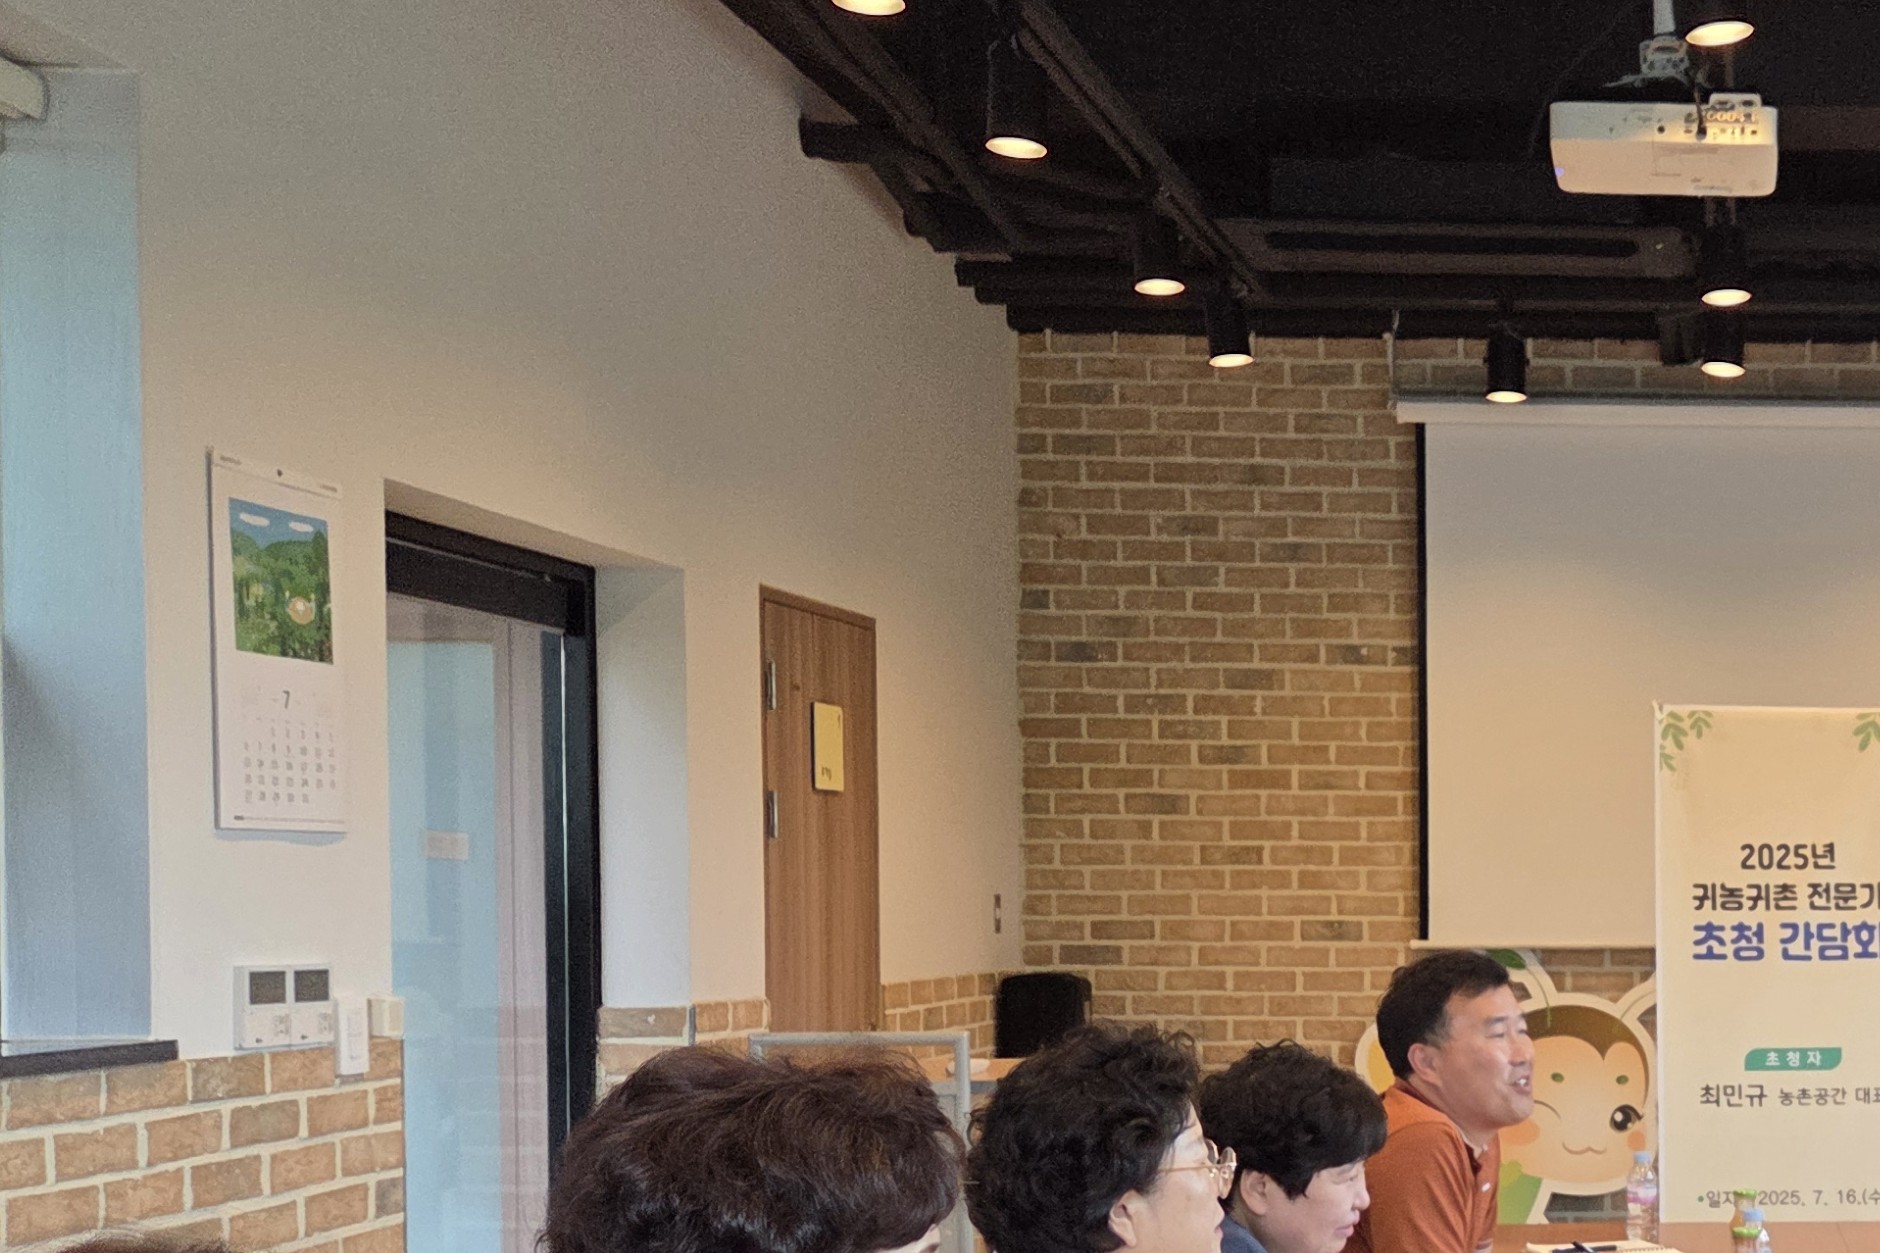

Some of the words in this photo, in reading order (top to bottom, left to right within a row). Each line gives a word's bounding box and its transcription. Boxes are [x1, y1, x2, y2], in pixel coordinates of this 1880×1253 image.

[282, 690, 290, 709] 7
[1740, 842, 1836, 870] 2025년
[1692, 882, 1798, 911] 귀농귀촌
[1692, 921, 1765, 961] 초청
[1700, 1083, 1767, 1108] 최민규
[1778, 1087, 1847, 1106] 농촌공간
[1759, 1189, 1806, 1207] 2025.
